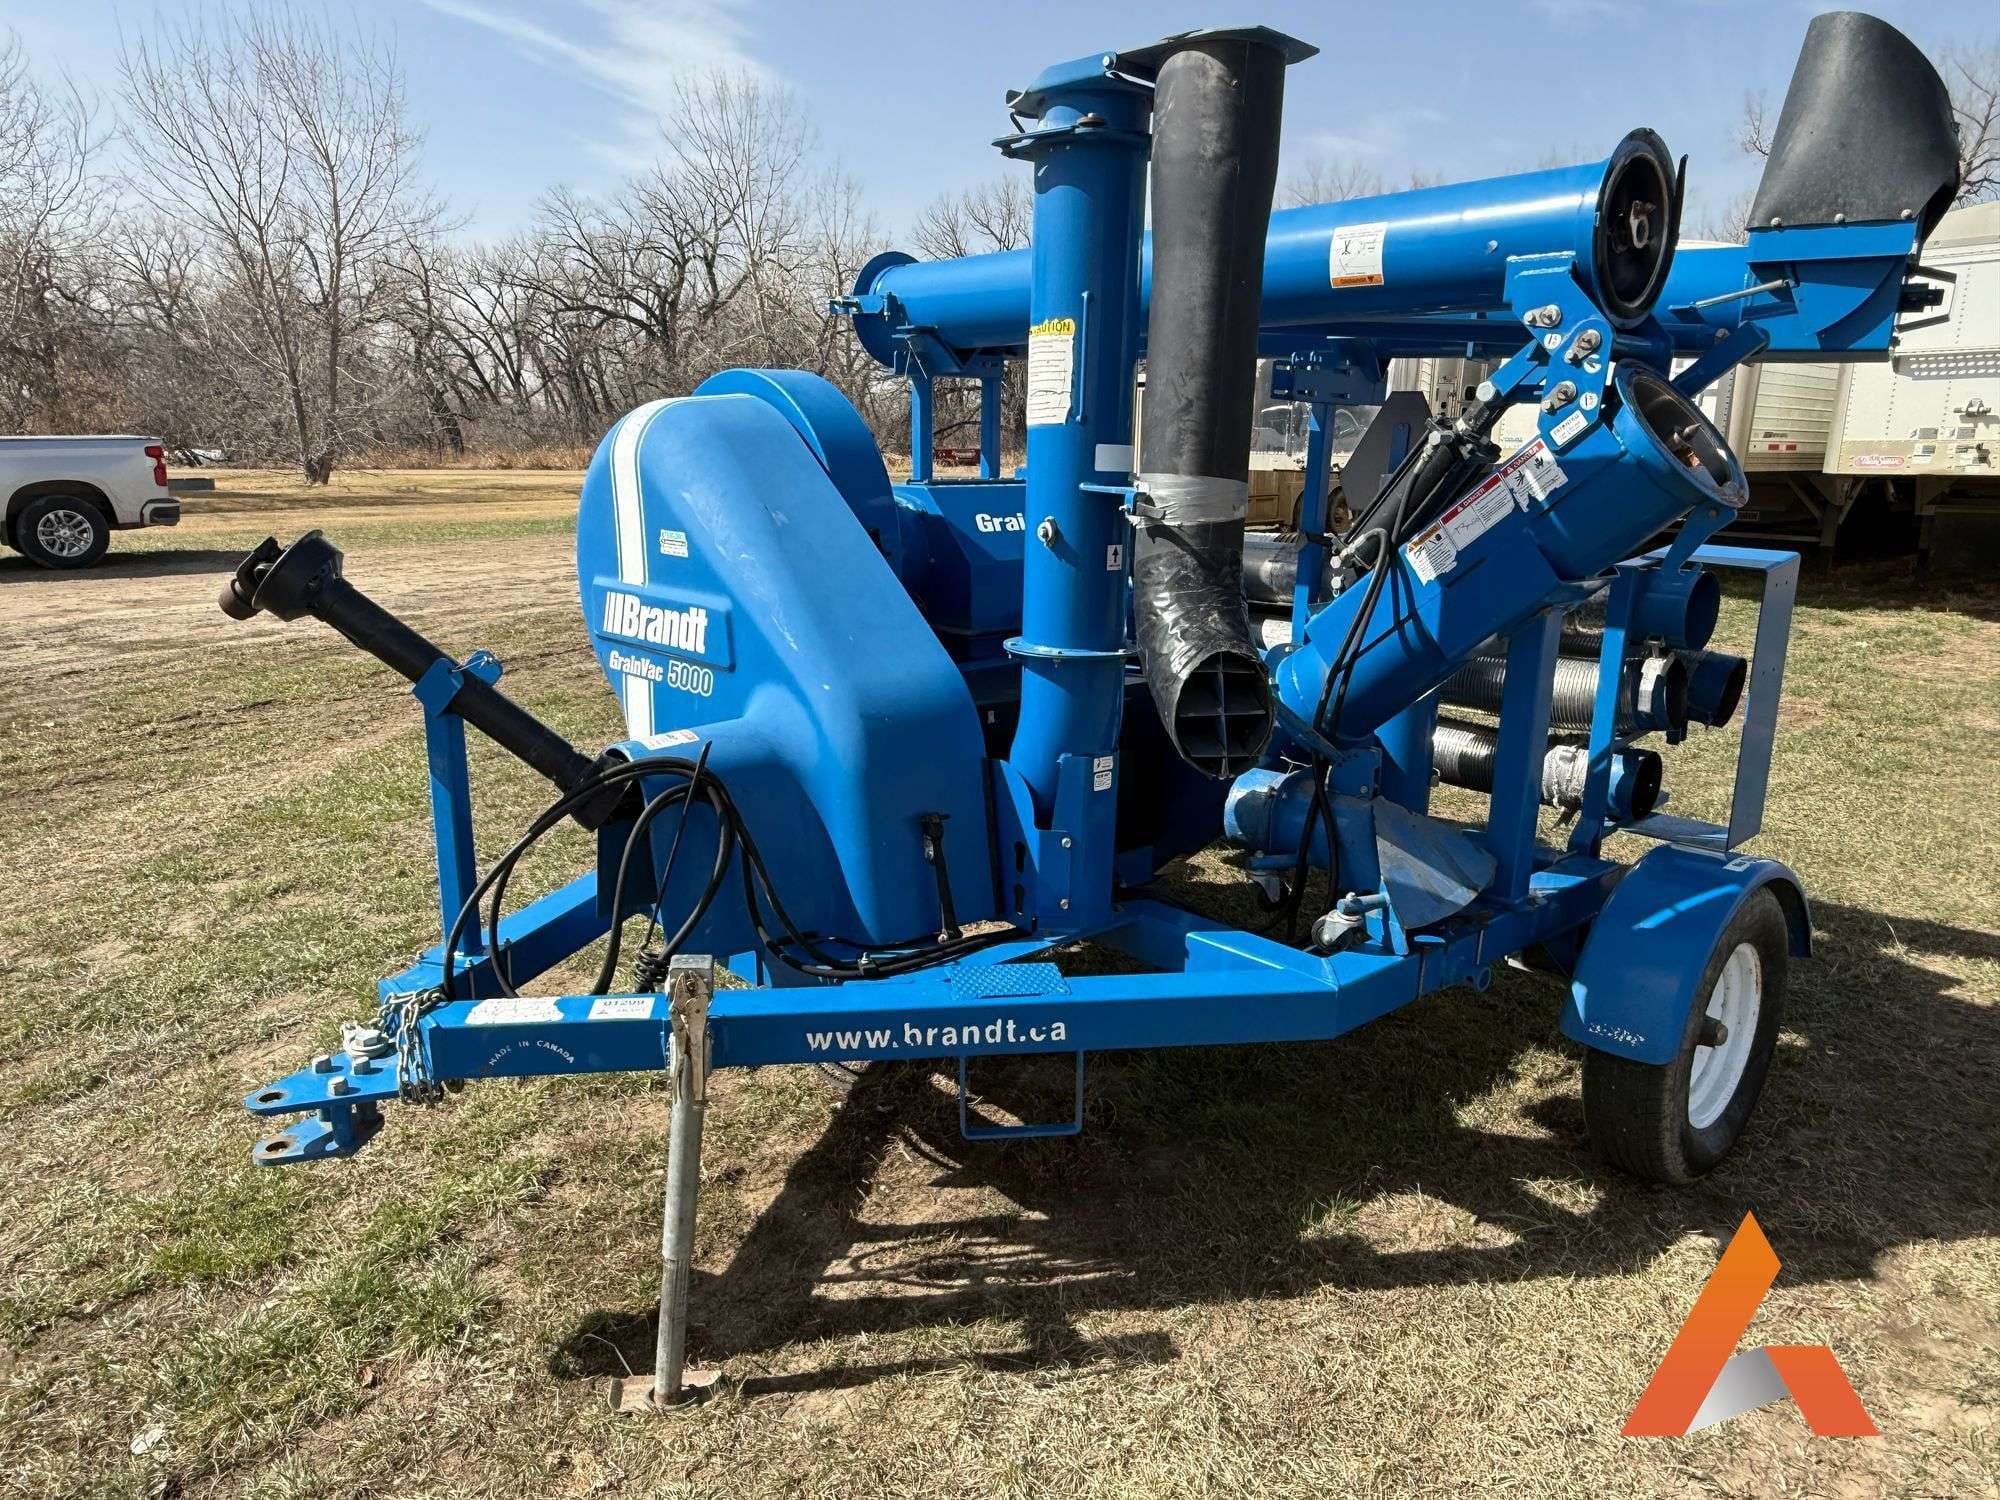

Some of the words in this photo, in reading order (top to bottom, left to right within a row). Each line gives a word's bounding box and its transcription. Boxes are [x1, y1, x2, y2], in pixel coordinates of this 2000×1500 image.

[975, 512, 1026, 533] Grai
[621, 592, 708, 655] Brandt
[609, 649, 664, 682] GrainVac
[667, 659, 714, 697] 5000
[806, 1018, 1067, 1051] www.brandt.ca
[536, 1039, 575, 1064] CANADA
